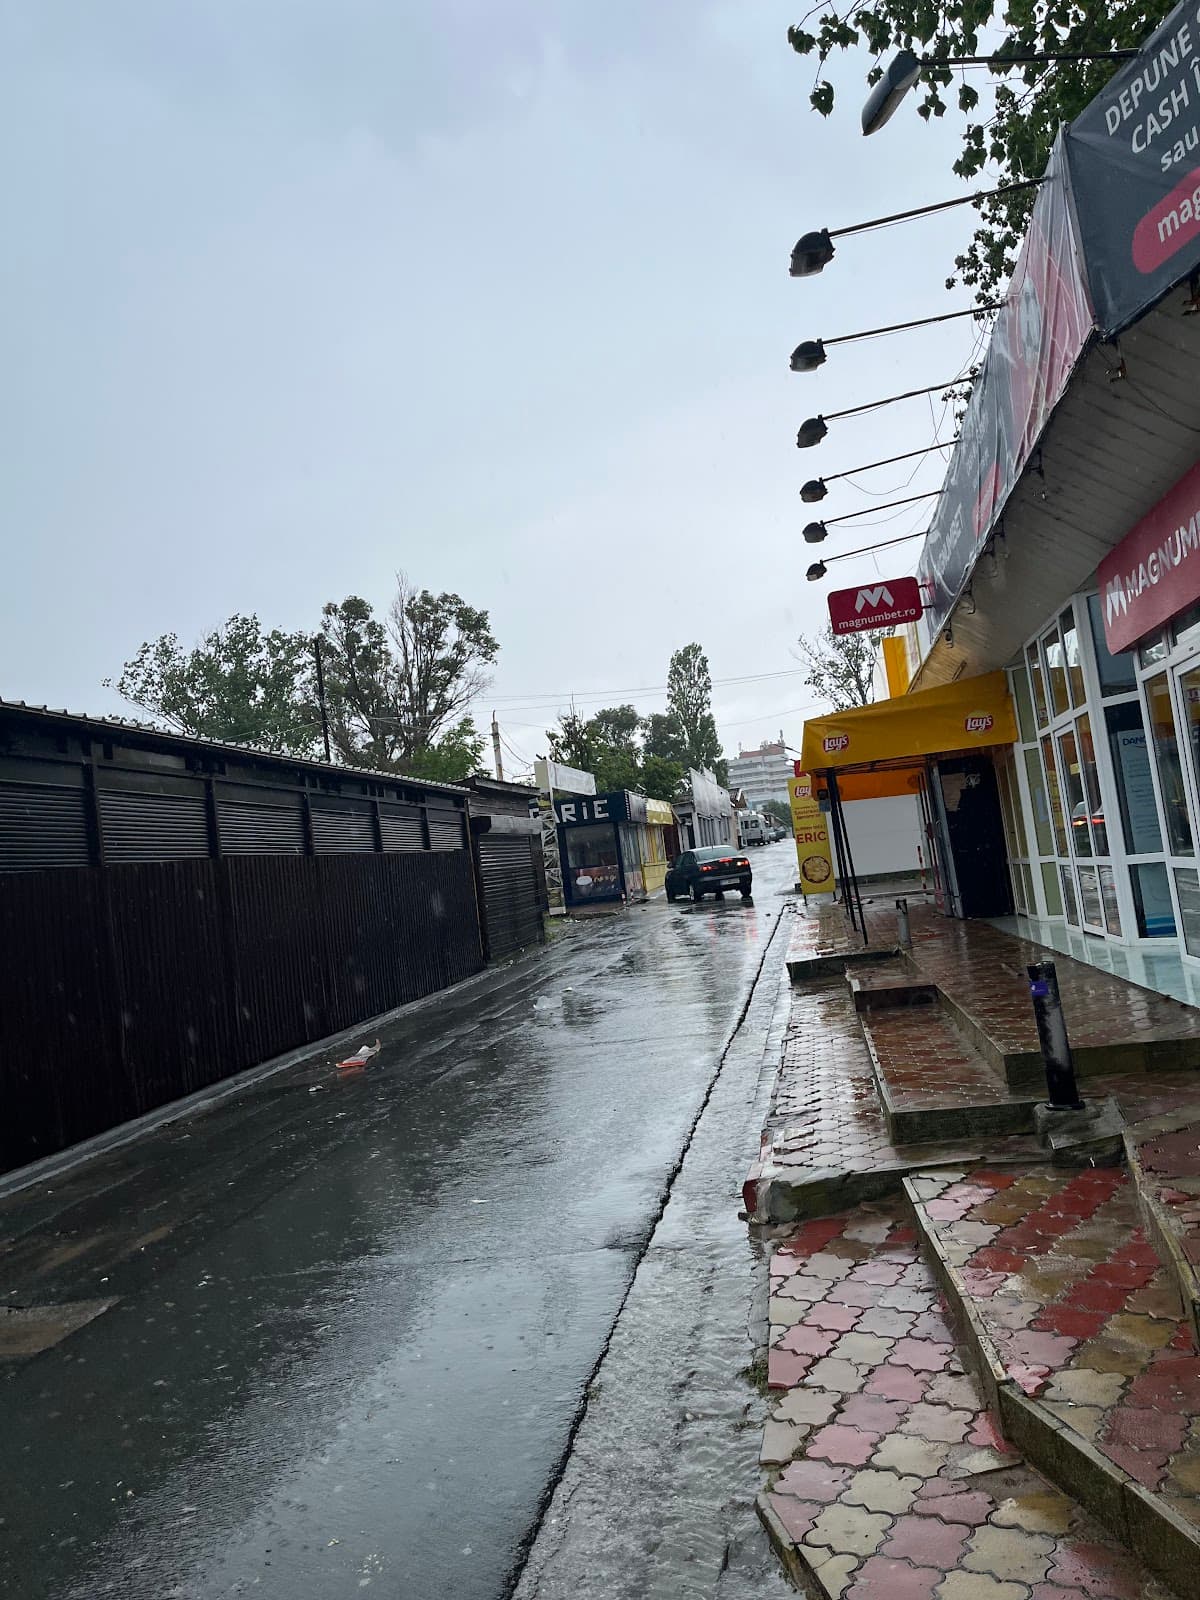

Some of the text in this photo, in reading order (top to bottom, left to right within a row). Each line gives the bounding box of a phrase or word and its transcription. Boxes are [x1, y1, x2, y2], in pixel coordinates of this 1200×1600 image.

[1105, 22, 1193, 136] DEPUNE
[1131, 79, 1190, 153] CASH
[1161, 125, 1199, 172] sau
[838, 608, 916, 630] magnumbet.ro
[797, 831, 827, 844] ERIC
